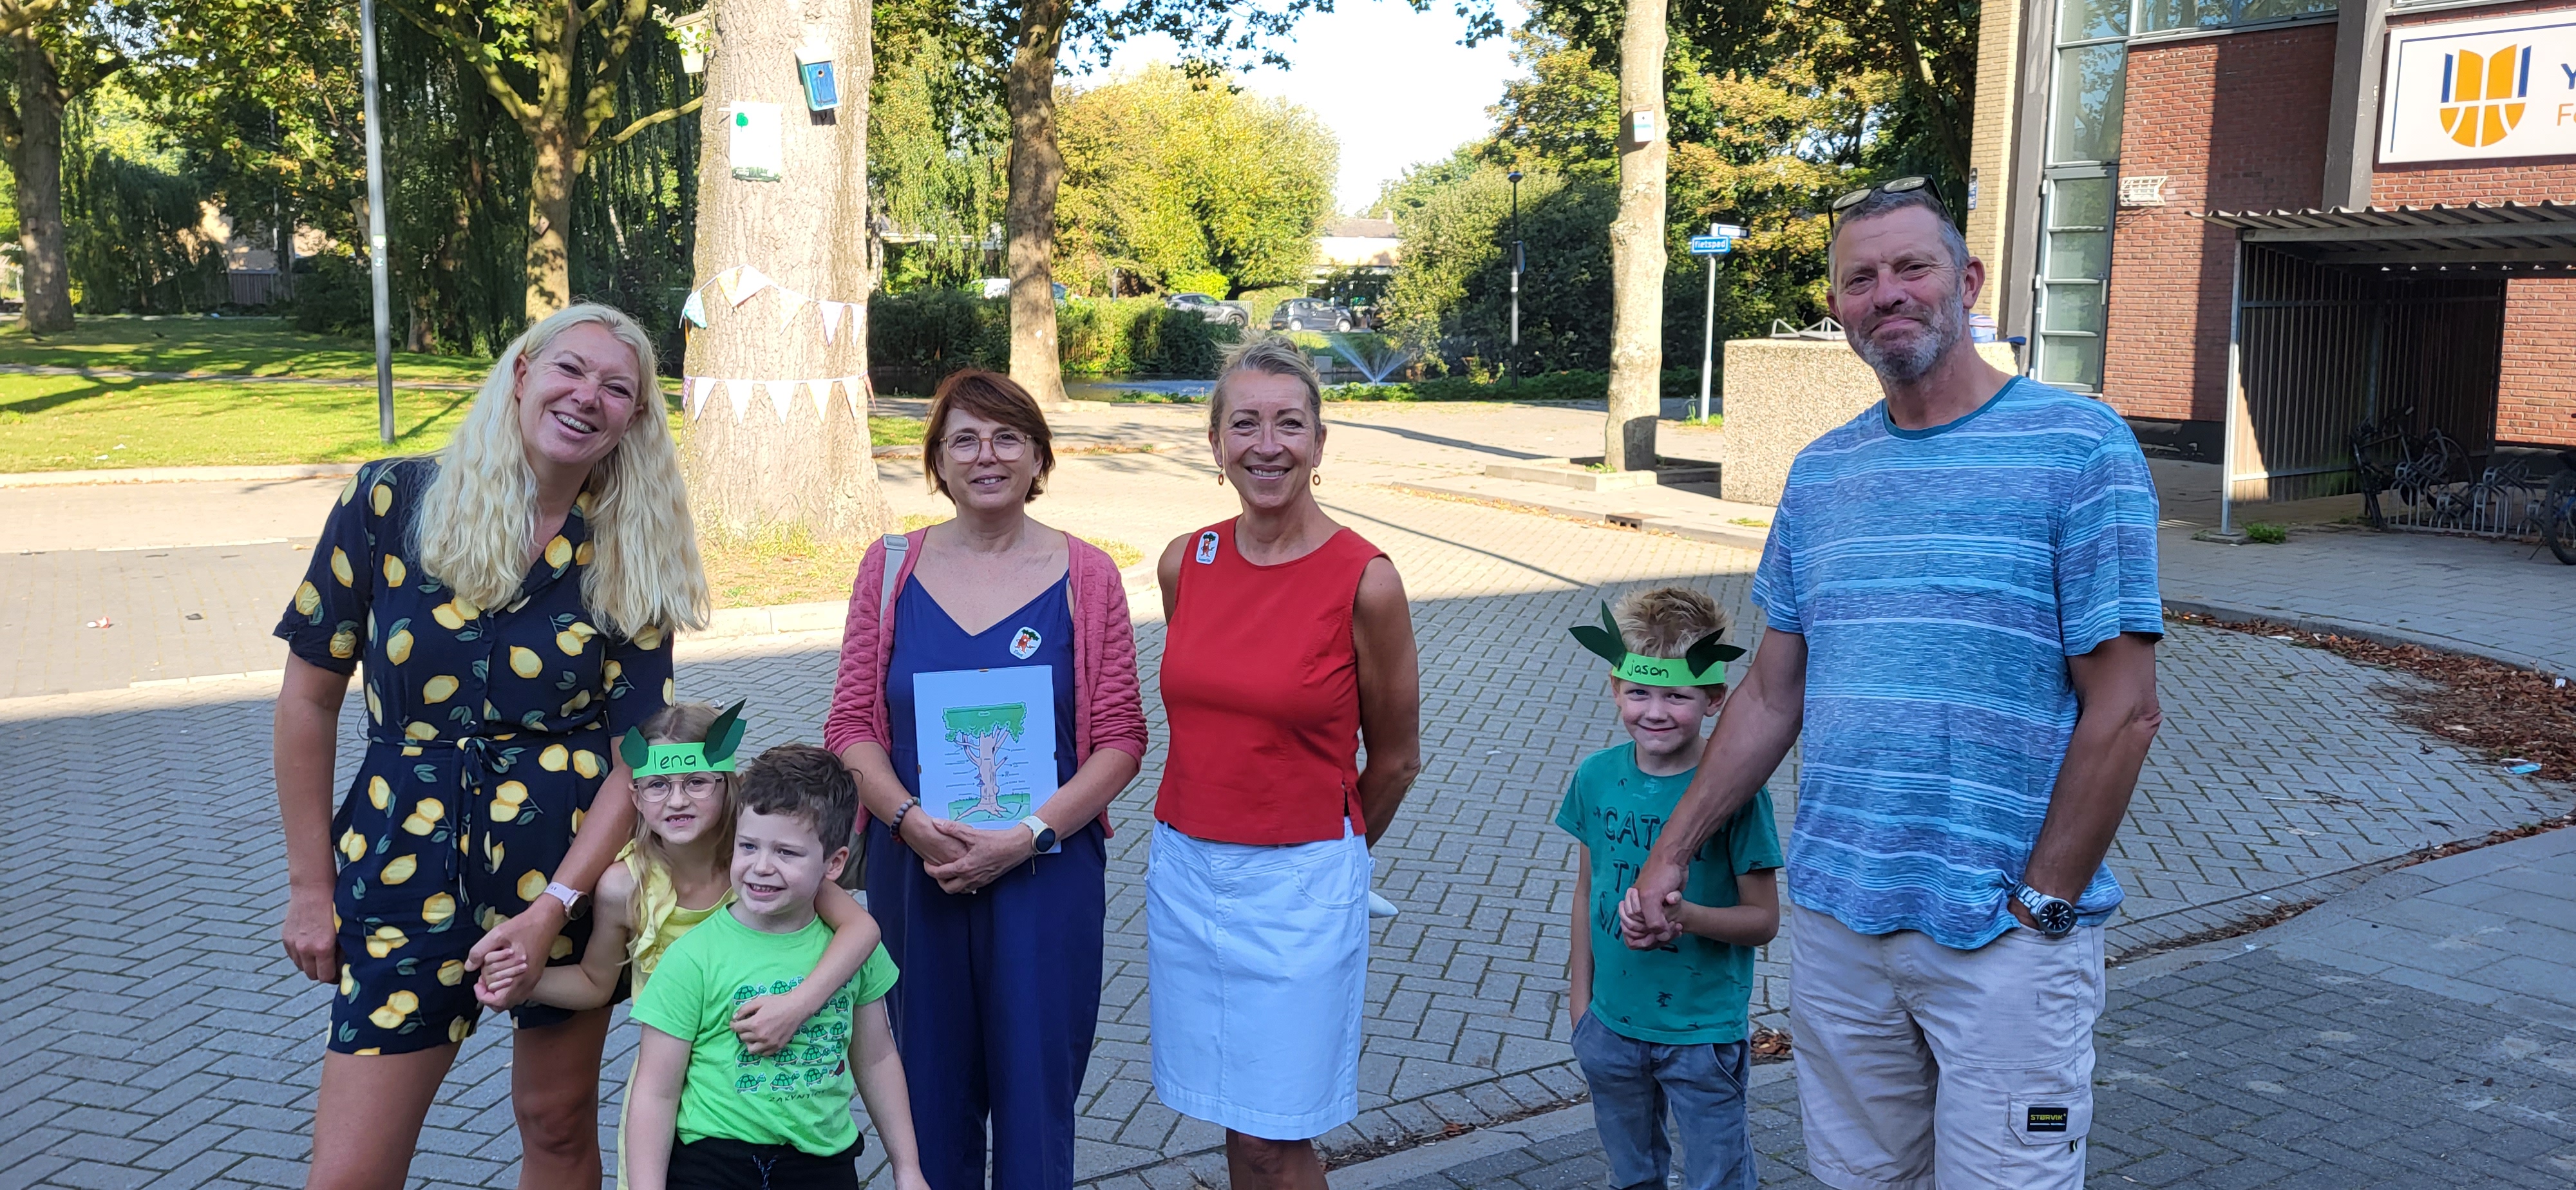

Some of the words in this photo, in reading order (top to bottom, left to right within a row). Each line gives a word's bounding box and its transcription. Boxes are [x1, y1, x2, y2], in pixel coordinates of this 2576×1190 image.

[2557, 103, 2576, 126] F
[1627, 659, 1669, 678] jason
[654, 750, 697, 770] lena
[1604, 806, 1669, 851] CAT
